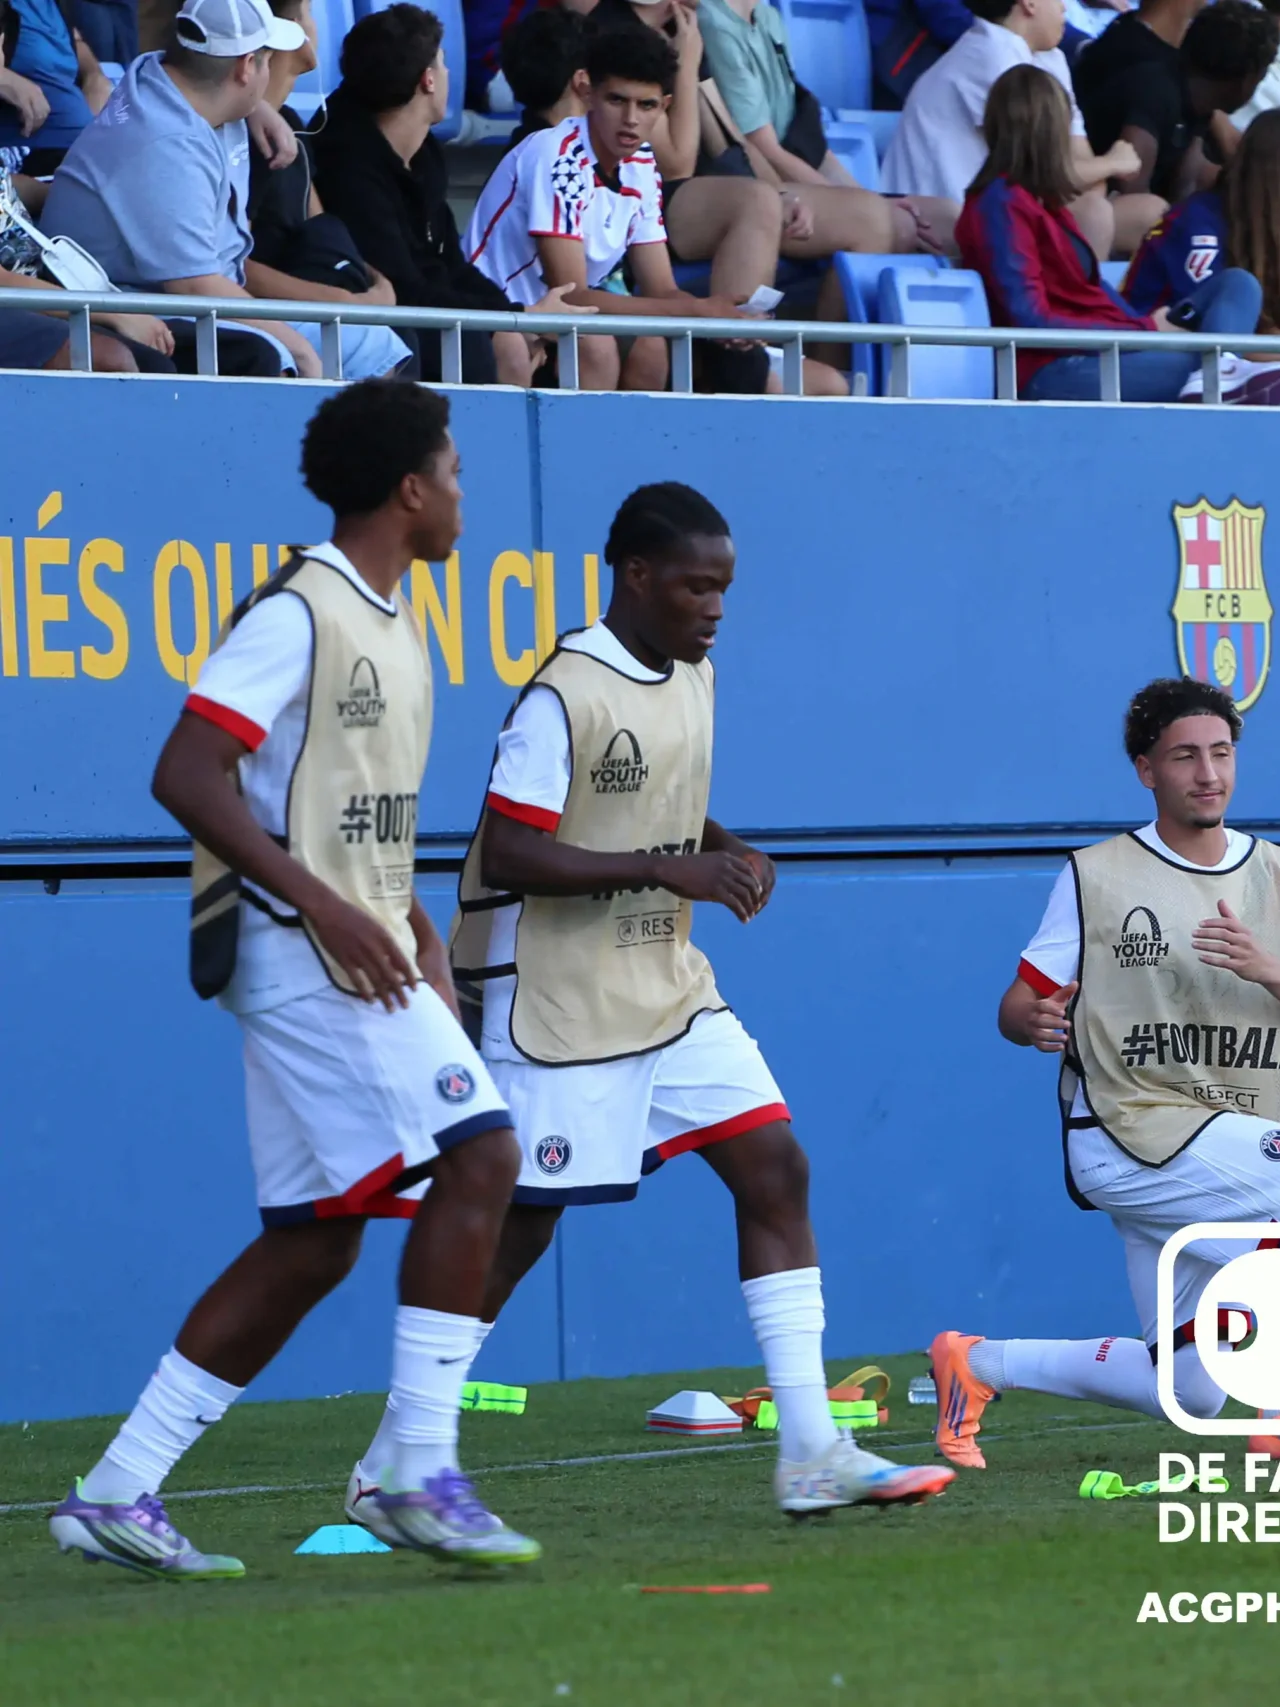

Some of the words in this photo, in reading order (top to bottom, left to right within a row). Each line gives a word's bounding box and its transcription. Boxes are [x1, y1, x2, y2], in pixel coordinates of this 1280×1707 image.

[1200, 593, 1242, 618] FCB
[336, 698, 387, 717] YOUTH
[601, 757, 631, 769] UEFA
[590, 764, 649, 784] YOUTH
[595, 781, 642, 793] LEAGUE
[641, 916, 676, 937] RES
[1121, 932, 1148, 943] UEFA
[1112, 942, 1170, 959] YOUTH
[1119, 956, 1160, 968] LEAGUE
